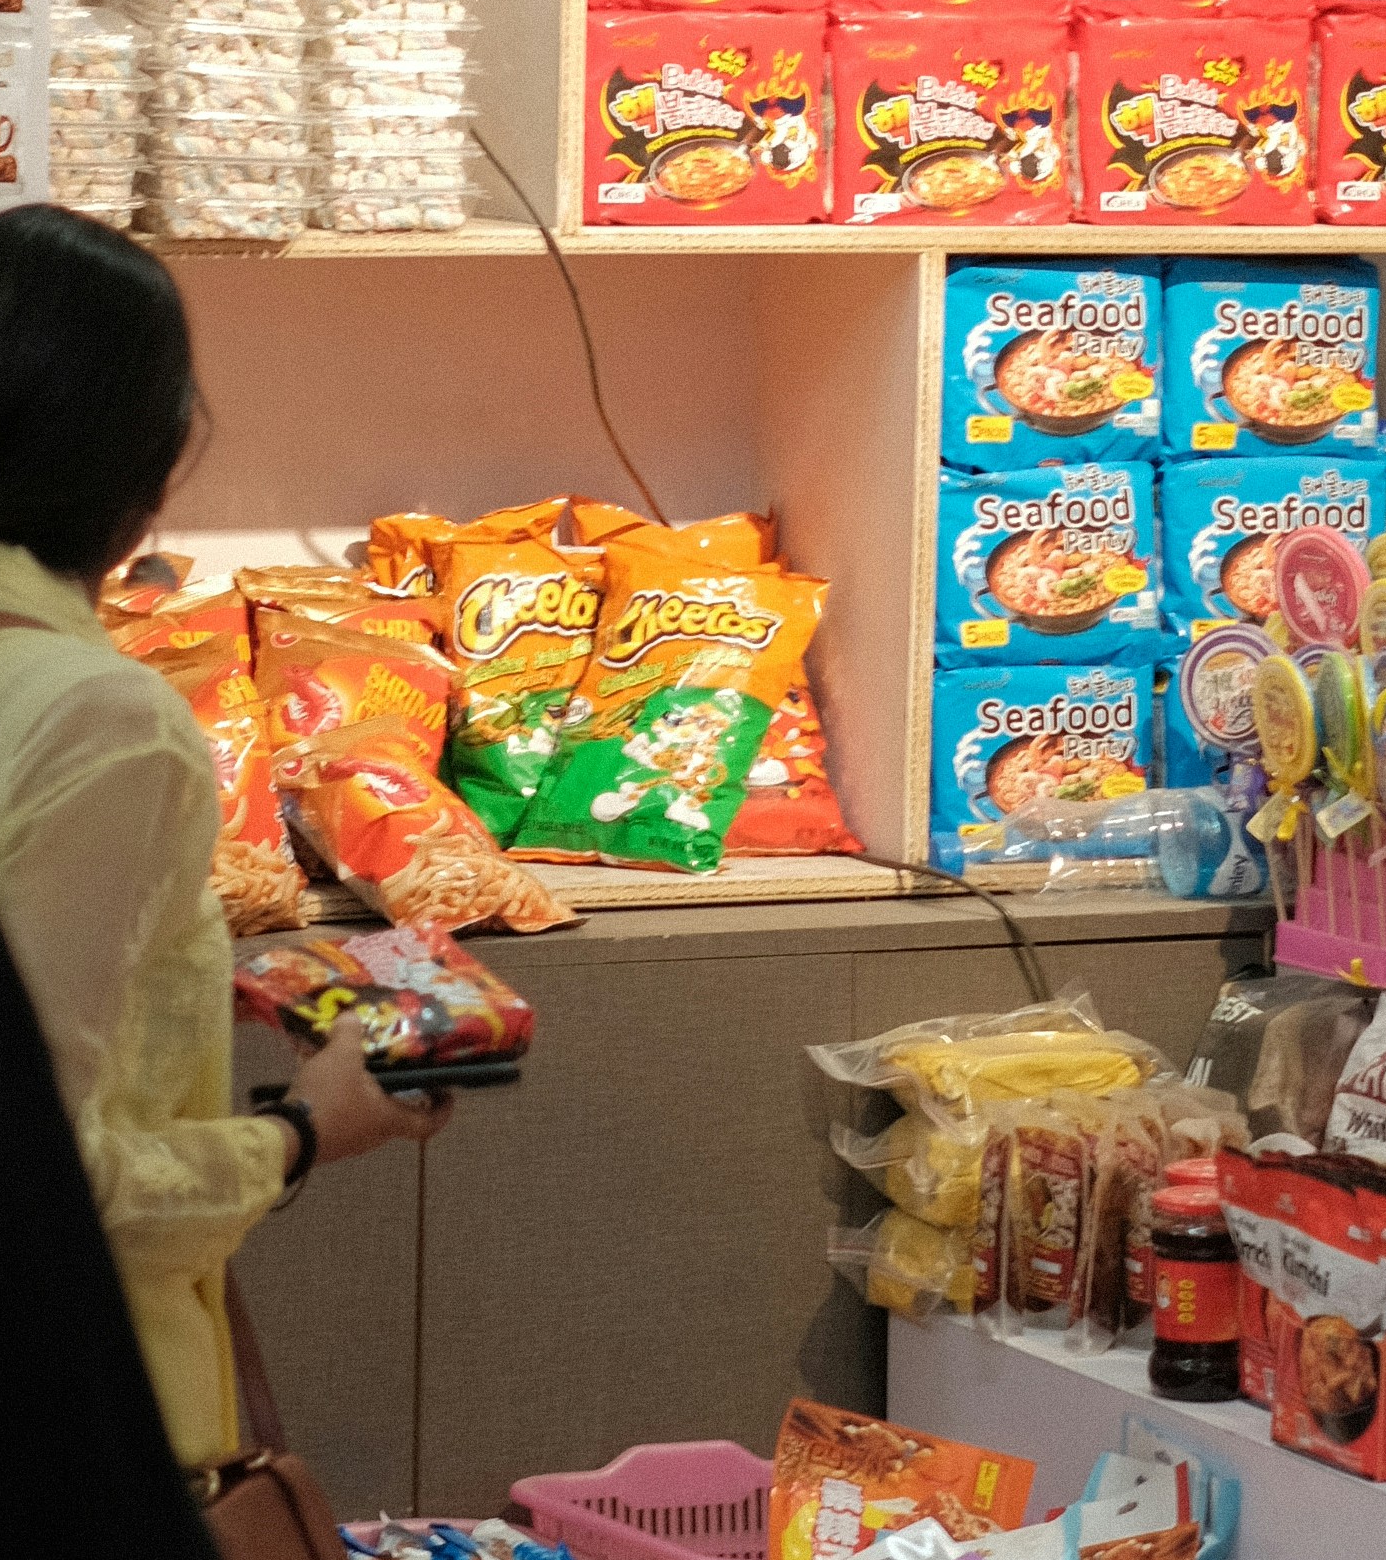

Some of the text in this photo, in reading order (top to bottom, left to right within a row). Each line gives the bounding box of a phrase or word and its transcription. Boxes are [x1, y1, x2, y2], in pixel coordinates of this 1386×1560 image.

[990, 293, 1142, 328] Seafood
[1219, 302, 1365, 336] Seafood
[1074, 333, 1142, 359] Party
[1298, 341, 1364, 370] Party
[978, 488, 1132, 531] Seafood
[1216, 498, 1365, 532] Seafood
[1063, 529, 1133, 554] Party
[981, 695, 1134, 735] Seafood
[1063, 734, 1135, 760] Party
